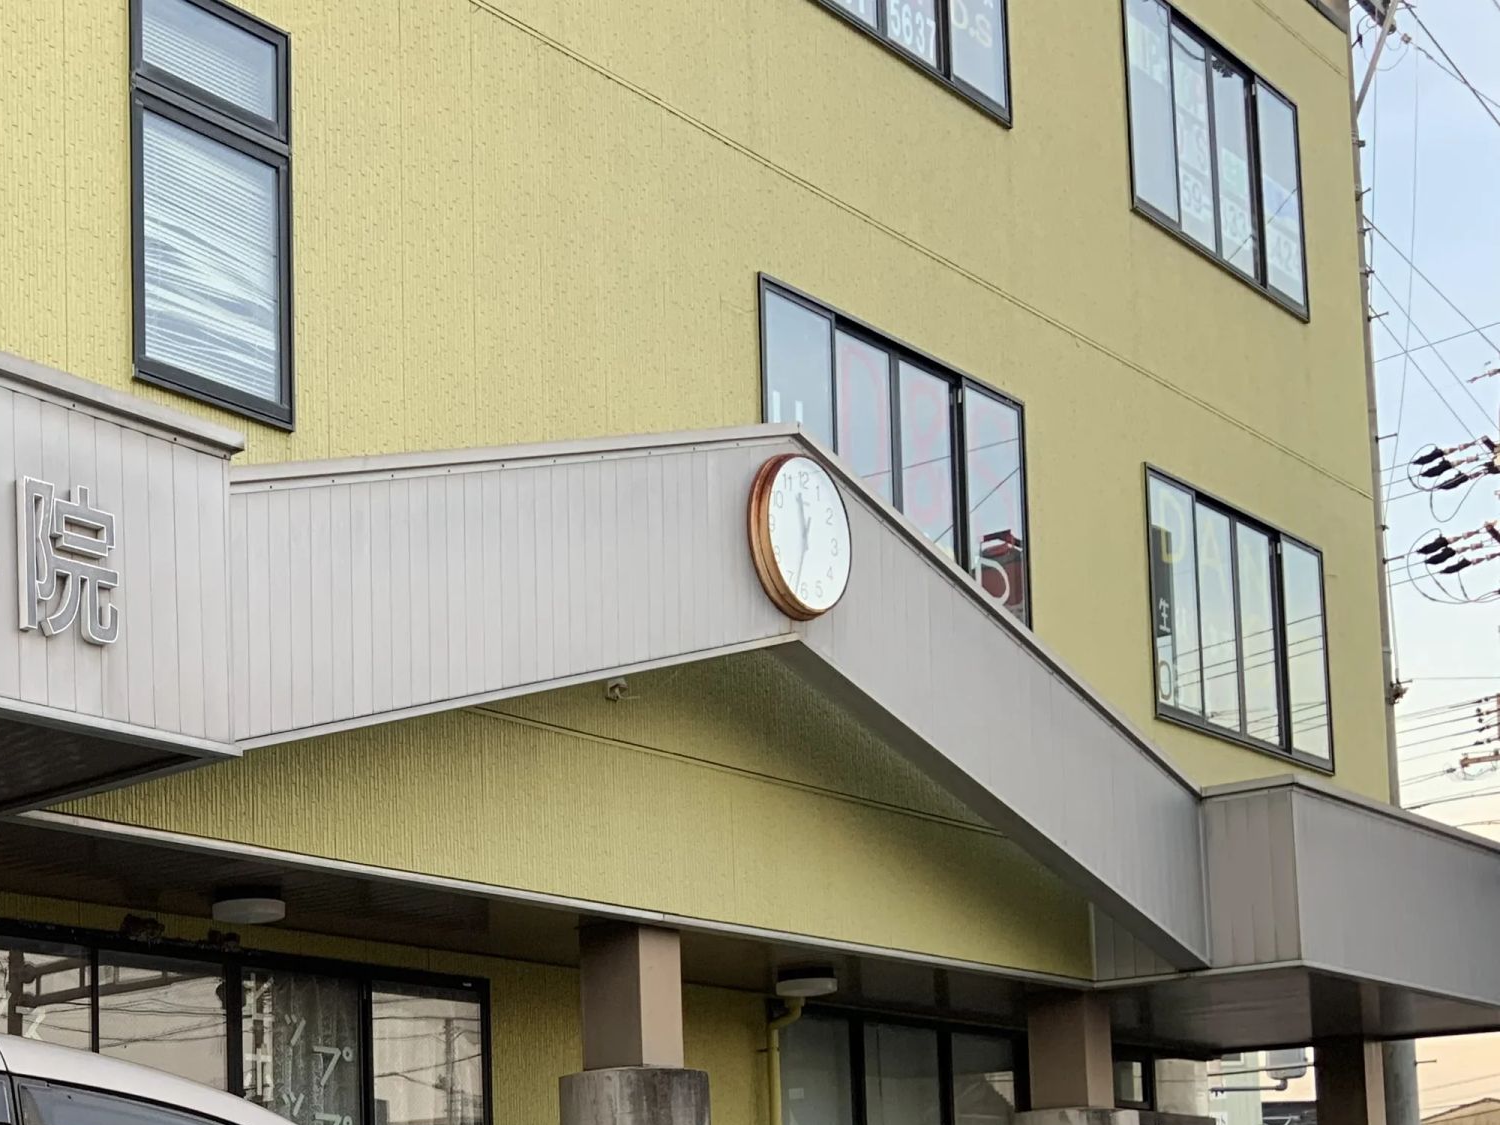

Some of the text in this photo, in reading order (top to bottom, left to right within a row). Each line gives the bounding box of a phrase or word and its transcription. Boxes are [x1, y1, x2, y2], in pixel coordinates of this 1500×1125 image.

[890, 0, 936, 58] 5637
[782, 473, 793, 491] 11
[798, 472, 809, 490] 12
[773, 490, 784, 509] 10
[826, 508, 834, 525] 2
[831, 538, 838, 557] 3
